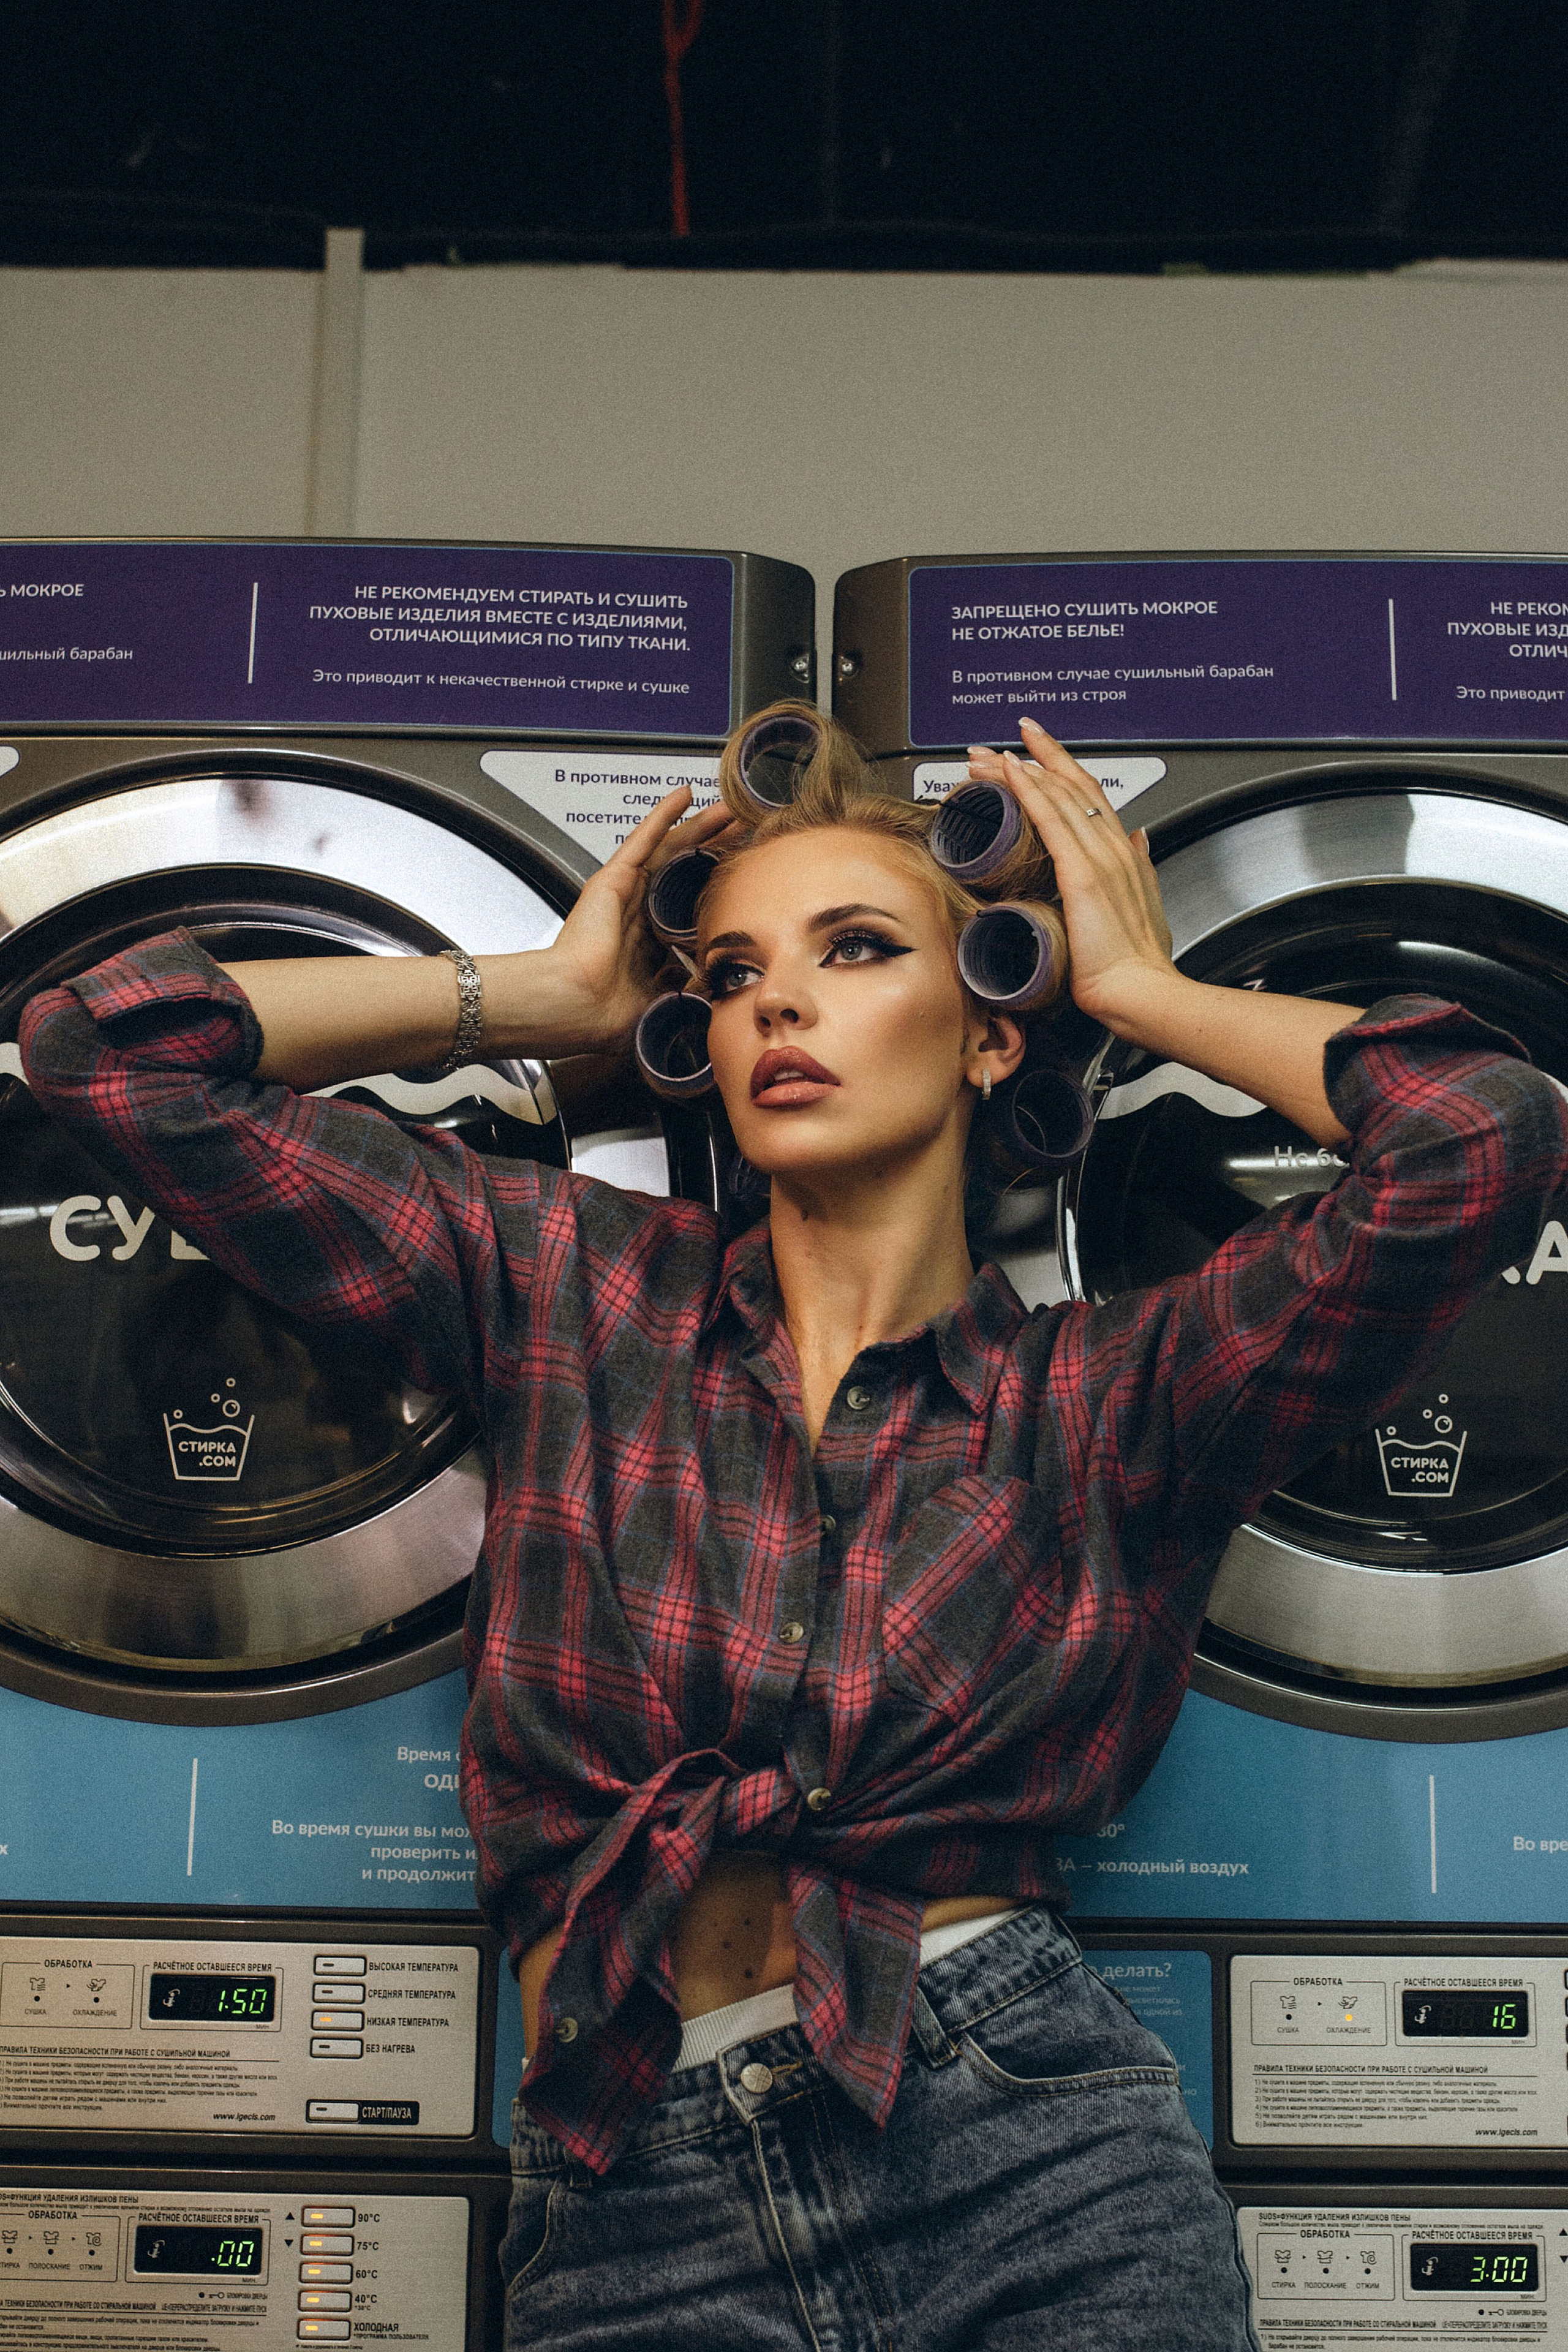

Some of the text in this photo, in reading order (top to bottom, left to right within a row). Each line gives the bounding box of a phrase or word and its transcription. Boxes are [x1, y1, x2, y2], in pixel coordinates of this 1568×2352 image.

[11, 584, 84, 597] МОКРОЕ
[355, 586, 688, 608] НЕ РЕКОМЕНДУЕМ СТИРАТЬ И СУШИТЬ
[952, 601, 1218, 620] ЗАПРЕЩЕНО СУШИТЬ МОКРОЕ
[1491, 602, 1513, 614] НЕ
[310, 606, 687, 631] ПУХОВЫЕ ИЗДЕЛИЯ ВМЕСТЕ С ИЗДЕЛИЯМИ,
[952, 624, 1124, 641] НЕ ОТЖАТОЕ БЕЛЬЕ!
[1448, 622, 1531, 636] ПУХОВЫЕ
[370, 628, 690, 651] ОТЛИЧАЮЩИМИСЯ ПО ТИПУ ТКАНИ.
[70, 647, 133, 662] барабан
[313, 669, 341, 683] Это
[346, 673, 420, 686] приводит
[427, 675, 435, 684] к
[440, 674, 565, 689] некачественной
[570, 679, 623, 692] стирке
[642, 683, 689, 694] сушке
[952, 665, 1273, 685] В противном случае сушильный барабан
[952, 690, 1126, 704] может выйти из строя
[1457, 686, 1564, 702] Это приводит
[556, 769, 565, 782] В
[571, 772, 660, 785] противном
[567, 812, 646, 824] посетите
[178, 1441, 236, 1453] СТИРКА
[1391, 1457, 1449, 1469] СТИРКА
[398, 1747, 450, 1763] Время
[272, 1820, 293, 1835] Во
[299, 1823, 350, 1838] время
[355, 1825, 409, 1839] сушки
[414, 1826, 435, 1838] вы
[1513, 1836, 1535, 1851] Во
[371, 1847, 461, 1861] проверить
[362, 1869, 372, 1880] и
[1097, 1859, 1185, 1875] холодный
[1190, 1862, 1250, 1877] воздух
[44, 1959, 92, 1968] ОБРАБОТКА
[154, 1961, 194, 1970] РАСЧЁТНОЕ
[197, 1962, 245, 1971] ОСТАВШЕЕСЯ
[369, 1962, 459, 1972] ВЫСОКАЯ ТЕМПЕРАТУРА
[1103, 1962, 1172, 1980] делать?
[1404, 1977, 1446, 1986] РАСЧЁТНОЕ
[368, 1990, 456, 2000] СРЕДНЯЯ ТЕМПЕРАТУРА
[367, 2018, 449, 2027] НИЗКАЯ ТЕМПЕРАТУРА
[1493, 2003, 1516, 2029] 16
[157, 2049, 195, 2057] СУШИЛЬНОЙ
[382, 2045, 415, 2053] НАГРЕВА
[362, 2106, 412, 2119] СТАРТ/ПАУЗА
[29, 2211, 77, 2219] ОБРАБОТКА
[138, 2212, 258, 2223] РАСЧЁТНОЕ ОСТАВШЕЕСЯ ВРЕМЯ
[358, 2214, 380, 2223] 90°C
[1412, 2230, 1532, 2240] РАСЧЁТНОЕ ОСТАВШЕЕСЯ ВРЕМЯ
[357, 2242, 379, 2250] 75°C
[356, 2270, 377, 2278] 60°C
[1470, 2256, 1528, 2283] 3.00
[355, 2294, 377, 2304] 40°C
[353, 2323, 398, 2332] ХОЛОДНАЯ
